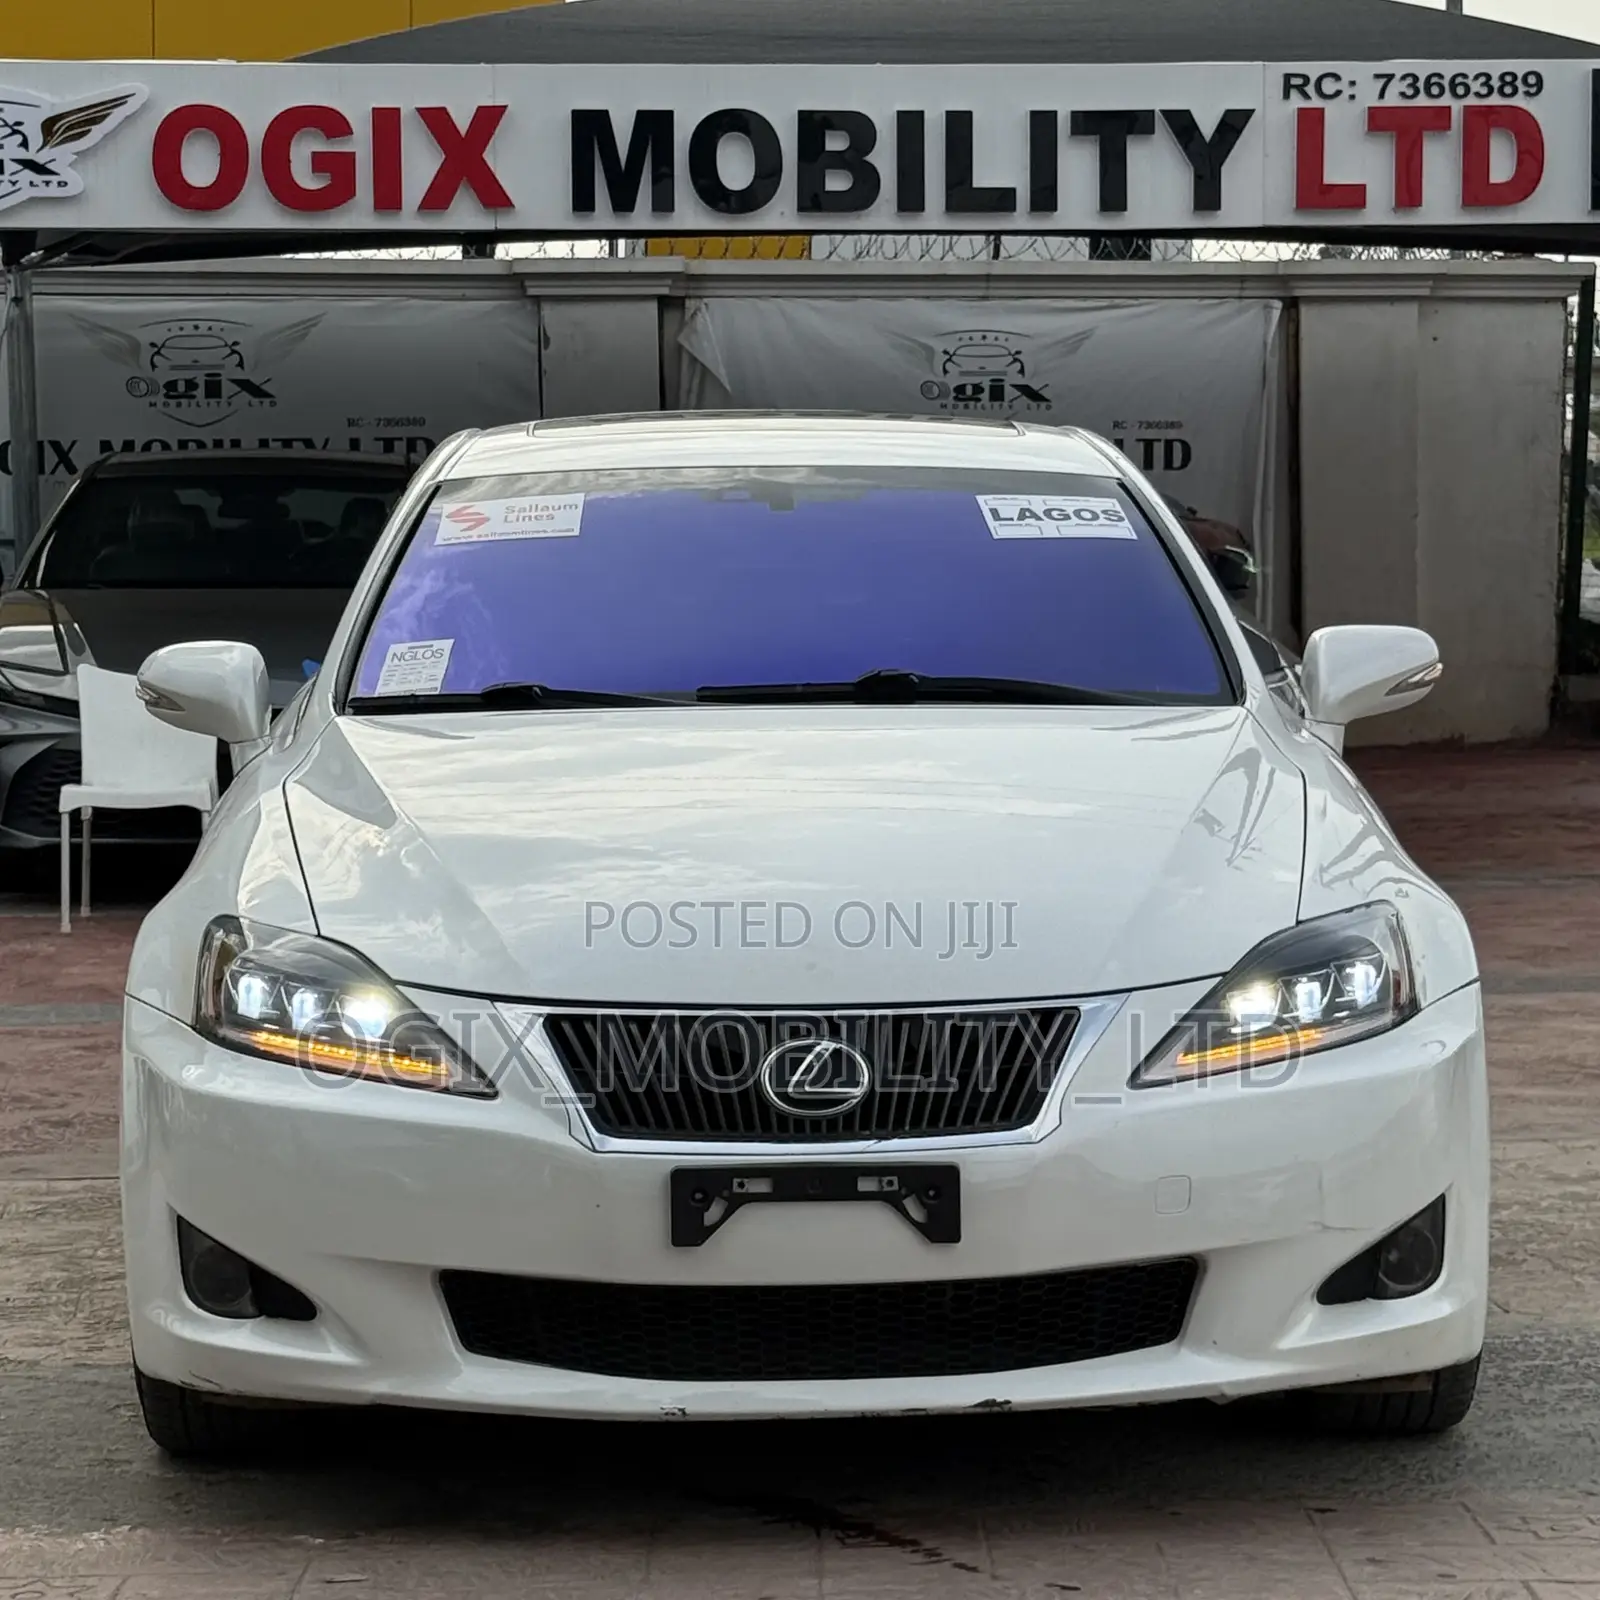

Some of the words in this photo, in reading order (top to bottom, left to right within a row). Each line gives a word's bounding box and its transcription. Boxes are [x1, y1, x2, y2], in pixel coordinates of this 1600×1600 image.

[1282, 72, 1358, 101] RC:
[1373, 70, 1545, 100] 7366389
[151, 103, 516, 212] OGIX
[570, 108, 1257, 213] MOBILITY
[1294, 104, 1546, 210] LTD
[29, 180, 69, 188] LTD
[504, 502, 579, 514] Sallaum
[988, 507, 1126, 523] LAGOS
[503, 511, 556, 523] Lines
[391, 648, 445, 662] NGLOS
